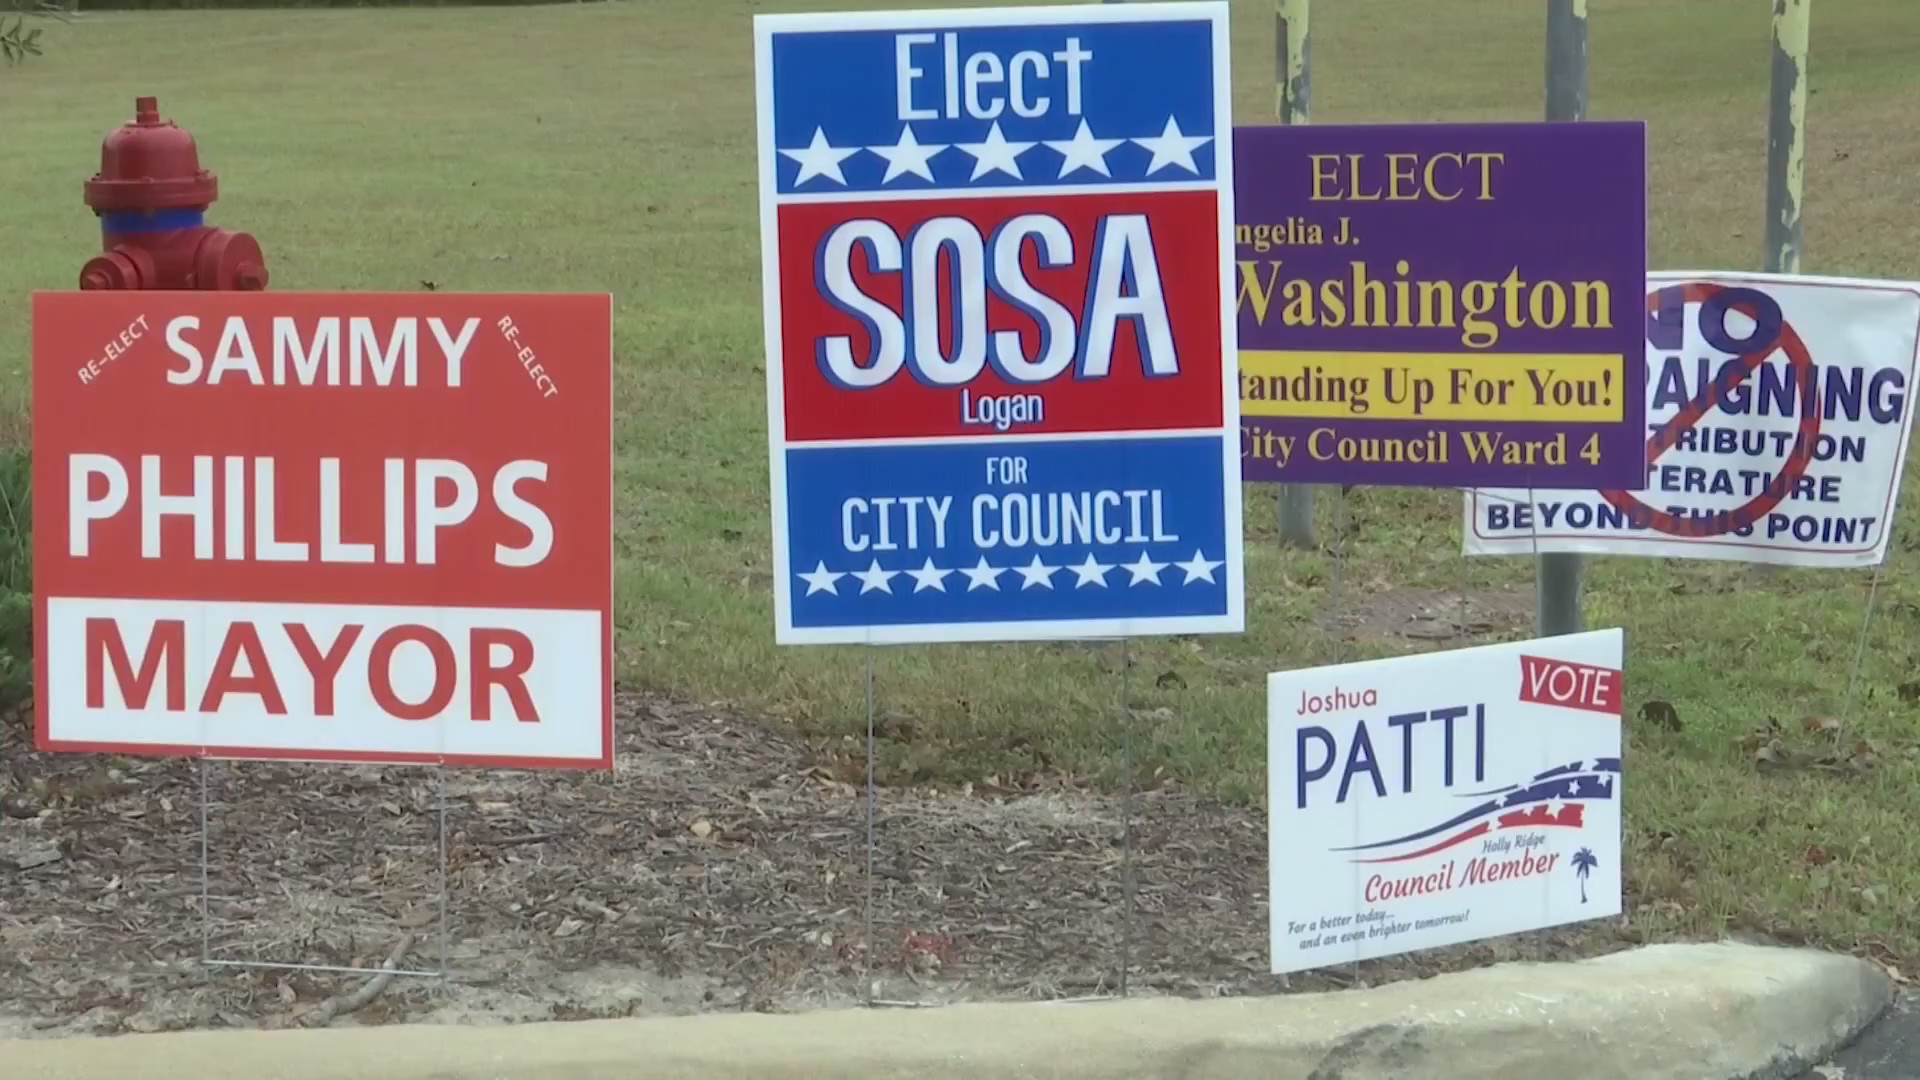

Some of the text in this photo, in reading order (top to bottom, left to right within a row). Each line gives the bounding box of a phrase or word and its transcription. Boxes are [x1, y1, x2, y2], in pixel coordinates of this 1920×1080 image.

[895, 32, 1093, 120] Elect
[1308, 152, 1504, 201] ELECT
[1235, 216, 1360, 252] ngelia J.
[814, 213, 1179, 390] SOSA
[77, 314, 149, 384] RE-ELECT
[165, 315, 481, 387] SAMMY
[497, 315, 558, 398] RE-ELECT
[961, 388, 1043, 430] Logan
[1238, 366, 1612, 415] tanding Up For You!
[987, 457, 1028, 484] FOR
[1307, 427, 1448, 464] Council
[1460, 432, 1566, 466] Ward
[1579, 433, 1601, 465] 4
[69, 453, 554, 567] PHILLIPS
[841, 490, 1178, 552] CITY COUNCIL
[1768, 513, 1876, 543] POINT
[85, 617, 541, 723] MAYOR
[1529, 662, 1612, 706] VOTE
[1297, 686, 1377, 715] Joshua
[1297, 703, 1485, 809] PATTI
[1482, 832, 1546, 854] Holly Ridge
[1365, 848, 1560, 903] Council Member
[1288, 921, 1306, 934] For
[1309, 922, 1317, 931] a
[1320, 915, 1352, 929] better
[1299, 933, 1321, 949] and
[1324, 934, 1337, 945] an
[1340, 930, 1366, 943] even
[1369, 921, 1411, 939] brighter
